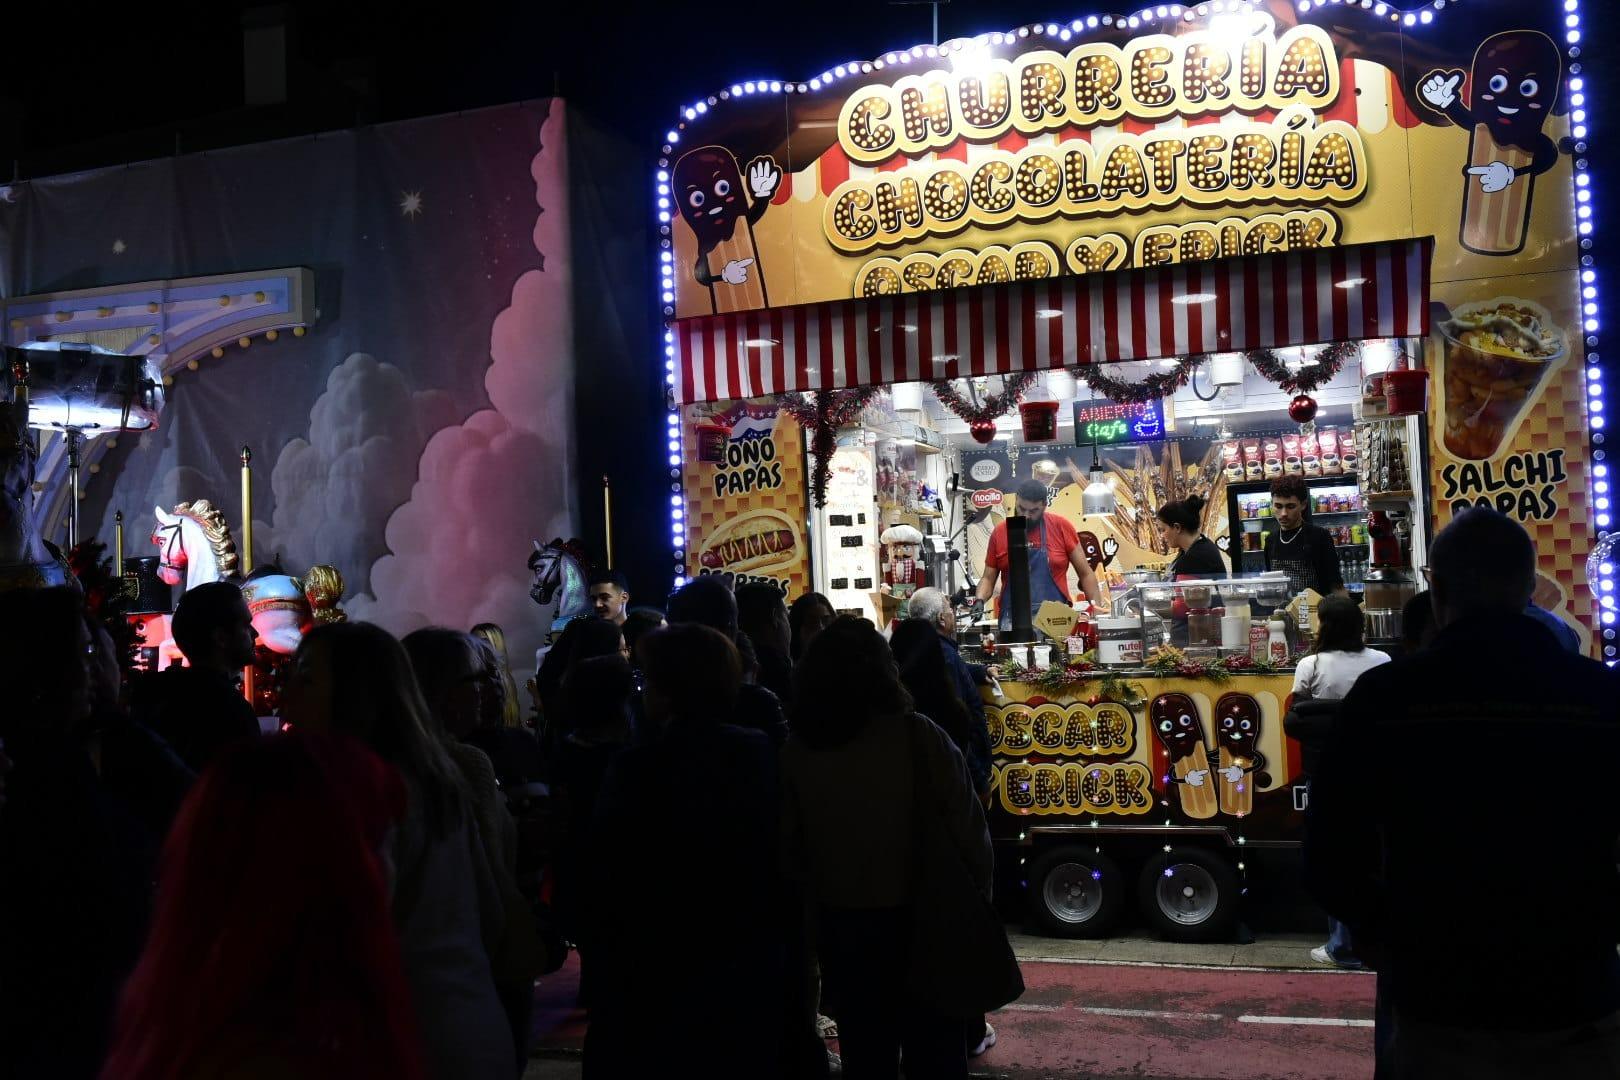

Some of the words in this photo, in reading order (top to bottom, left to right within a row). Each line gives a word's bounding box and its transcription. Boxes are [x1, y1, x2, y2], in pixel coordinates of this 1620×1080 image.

[848, 22, 1327, 152] CHURRERÍA
[834, 112, 1358, 240] CHOCOLATERÍA
[1080, 402, 1146, 422] ABIERTO
[716, 438, 775, 470] ONO
[1443, 449, 1567, 499] SALCHI
[715, 462, 782, 497] PAPAS
[975, 492, 1001, 502] nocilla
[984, 709, 1127, 749] OSCAR
[1006, 767, 1146, 808] ERICK
